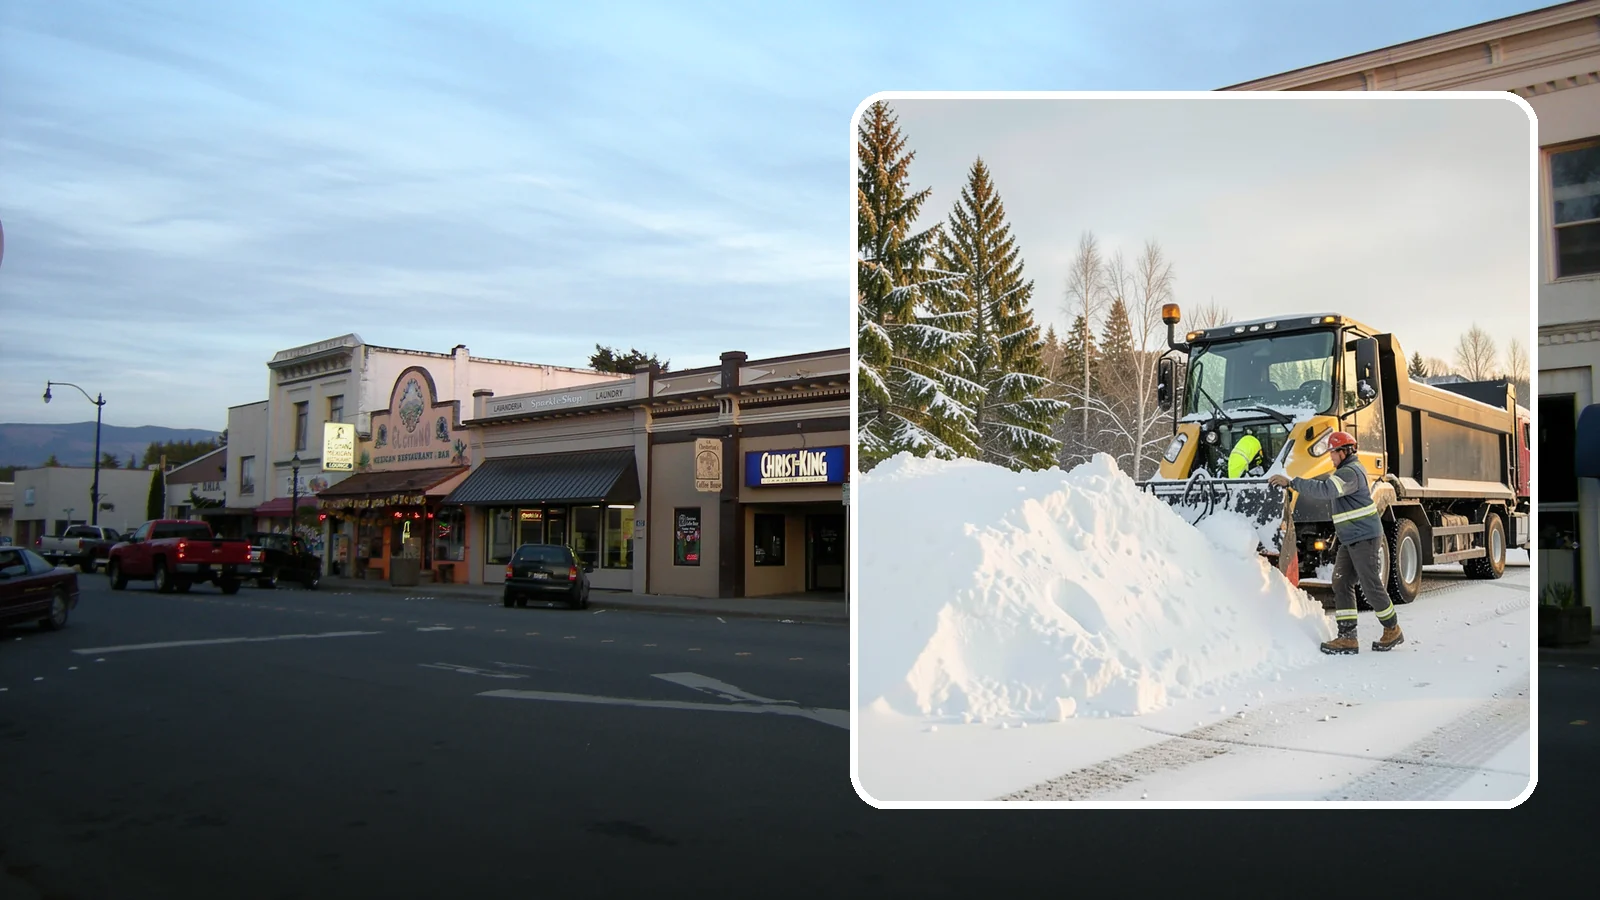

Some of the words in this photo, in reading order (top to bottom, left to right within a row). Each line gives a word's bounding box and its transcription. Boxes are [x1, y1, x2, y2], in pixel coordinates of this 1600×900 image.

[595, 389, 624, 400] LAUNDRY
[494, 402, 522, 413] LAVANDERIA
[531, 396, 562, 409] Sparkle
[562, 394, 582, 404] Shop
[374, 454, 396, 464] MEXICAN
[397, 451, 433, 462] RESTAURANT
[438, 450, 450, 459] BAR
[760, 452, 797, 478] CHRIST
[799, 450, 827, 476] KING
[697, 480, 709, 488] Coffee
[710, 480, 721, 488] House
